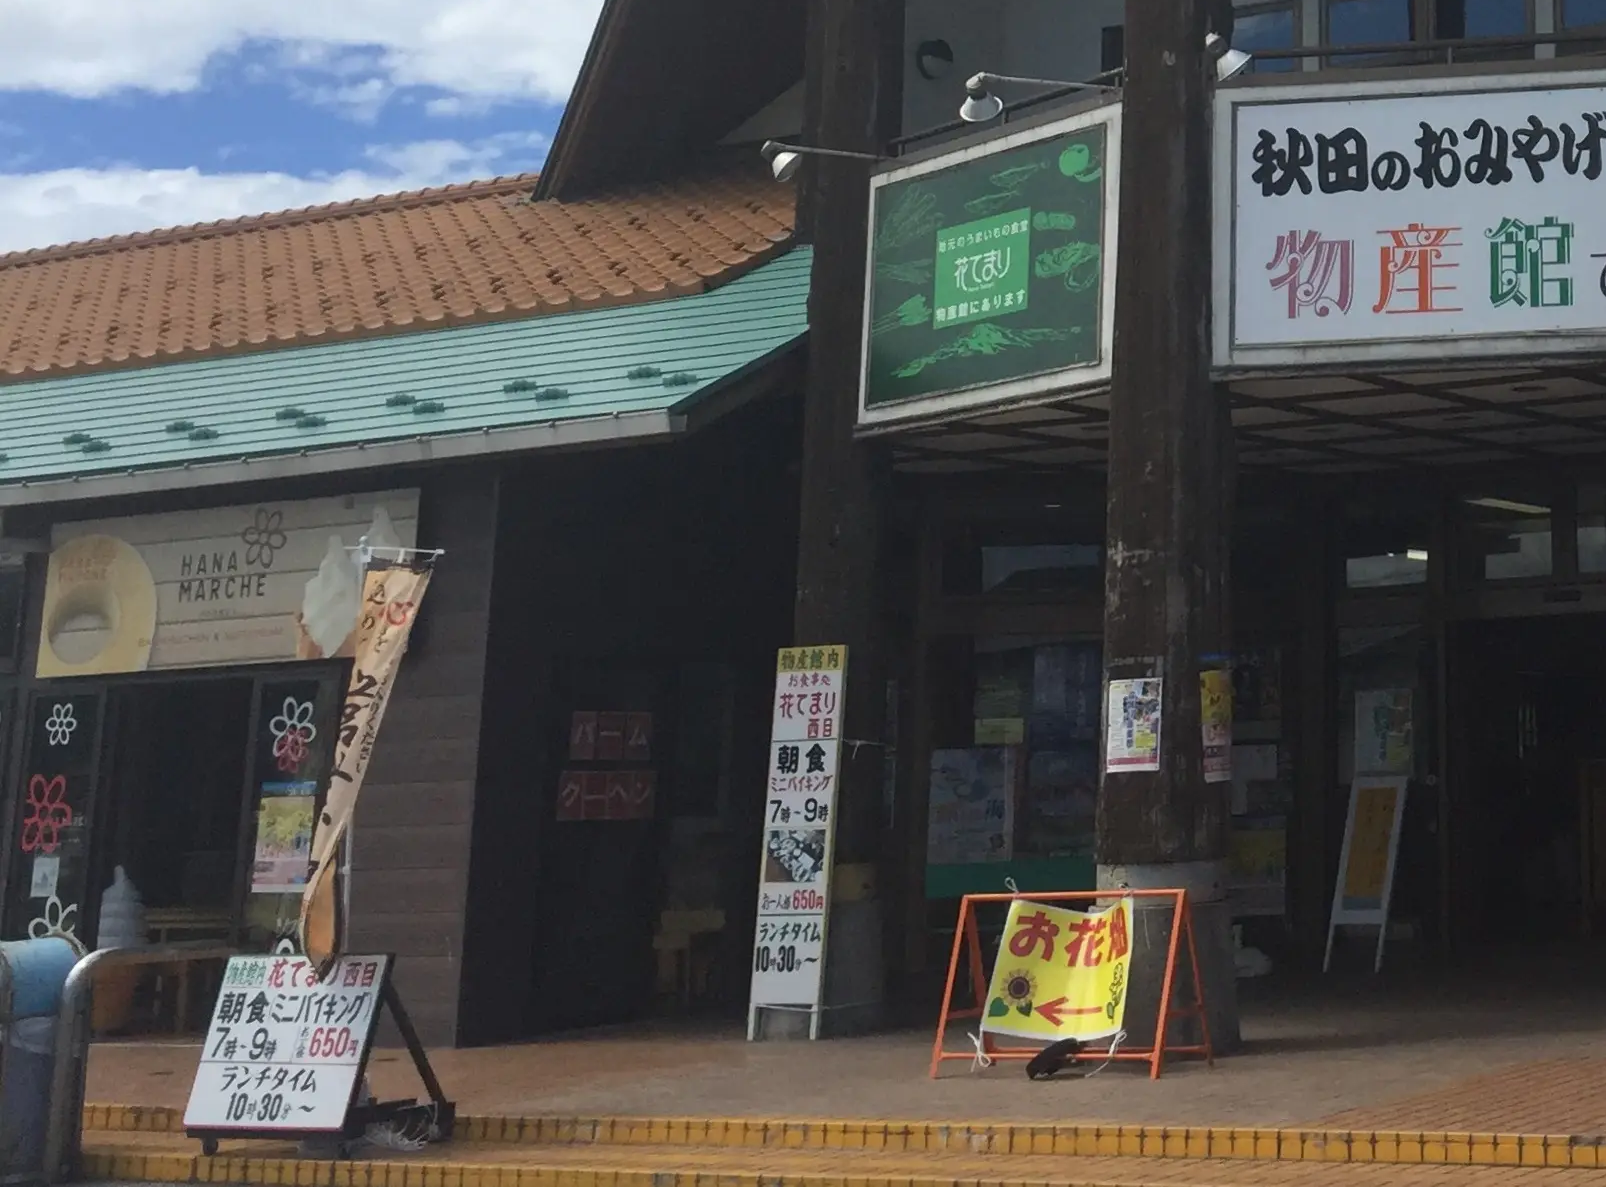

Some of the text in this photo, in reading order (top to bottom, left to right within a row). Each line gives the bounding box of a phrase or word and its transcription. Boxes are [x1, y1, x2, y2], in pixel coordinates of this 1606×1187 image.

[954, 246, 1011, 292] 花てまり
[181, 551, 238, 576] HANA
[178, 574, 267, 603] MARCHE
[781, 648, 840, 670] 物産館内
[788, 672, 831, 688] お食事処
[779, 691, 836, 719] 花てまり
[807, 718, 833, 739] 西目
[776, 743, 827, 774] 朝食
[771, 773, 834, 792] ミニバイキング
[759, 921, 822, 943] ランチタイム
[309, 1026, 360, 1059] 650円
[220, 1065, 317, 1093] ランチタイム
